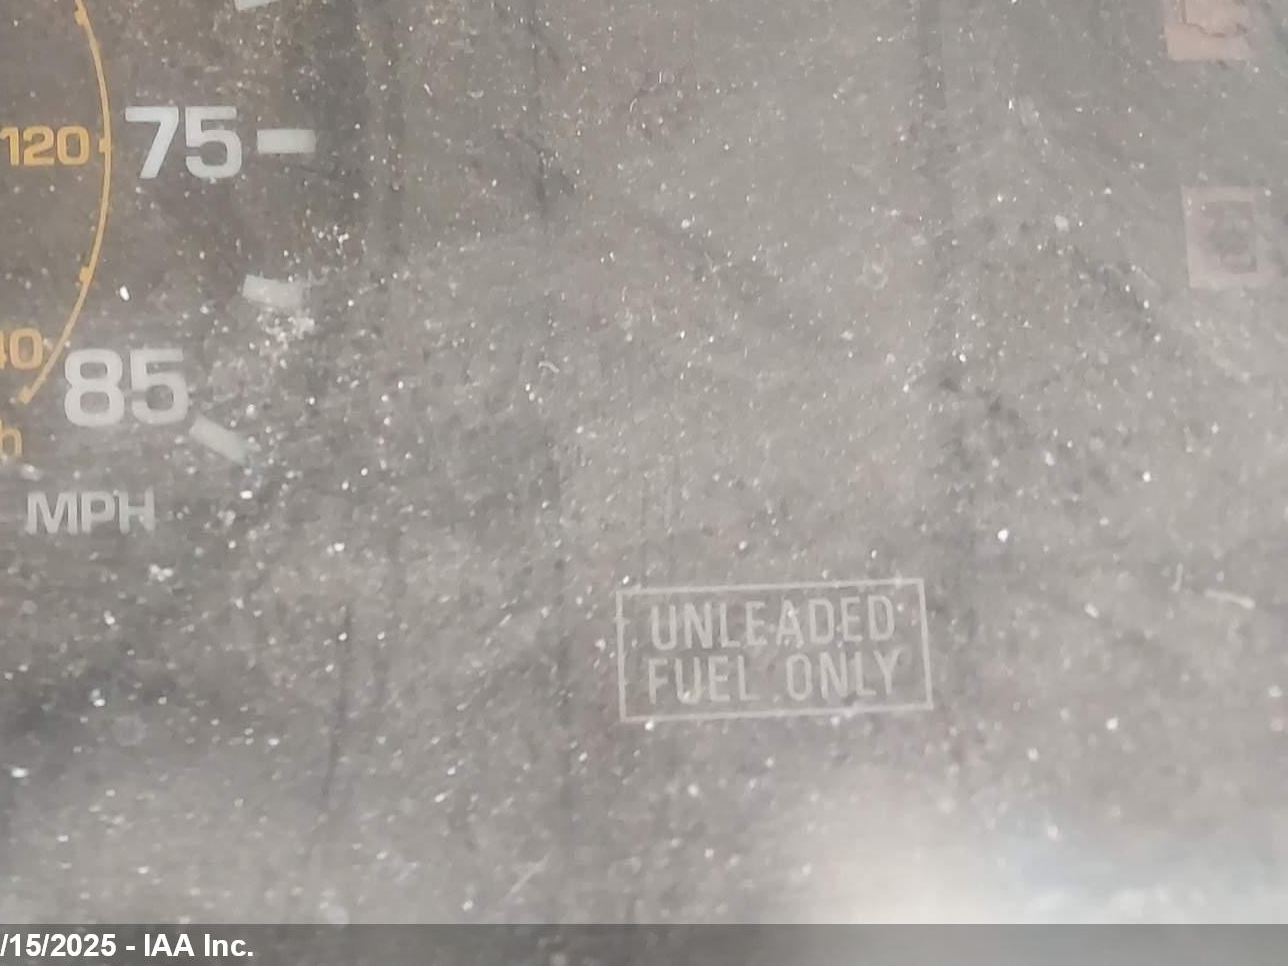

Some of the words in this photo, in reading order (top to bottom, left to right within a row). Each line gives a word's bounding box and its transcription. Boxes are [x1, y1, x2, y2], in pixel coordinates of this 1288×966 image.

[0, 125, 91, 166] 120
[125, 106, 243, 179] 75
[64, 348, 189, 427] 85
[25, 490, 156, 534] MPH
[649, 594, 896, 651] UNLEADED
[647, 655, 761, 705] FUEL
[786, 649, 902, 701] ONLY
